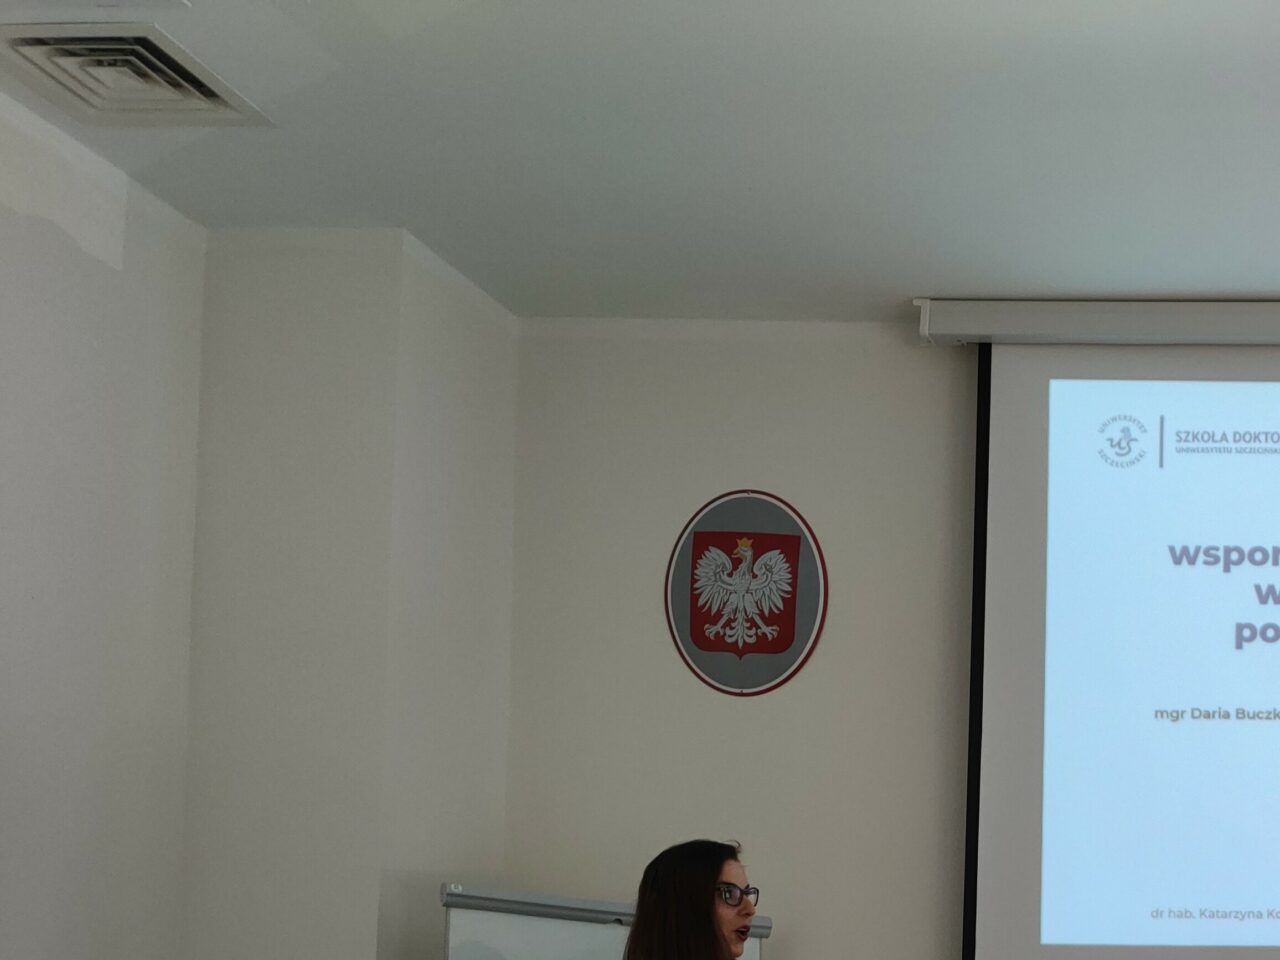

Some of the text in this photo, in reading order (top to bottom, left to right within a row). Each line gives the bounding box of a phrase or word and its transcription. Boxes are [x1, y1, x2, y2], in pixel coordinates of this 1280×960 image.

[1154, 709, 1187, 722] mgr
[1190, 707, 1231, 720] Daria
[1150, 907, 1165, 919] dr
[1167, 907, 1196, 919] hab.
[1199, 907, 1264, 922] Katarzyna
